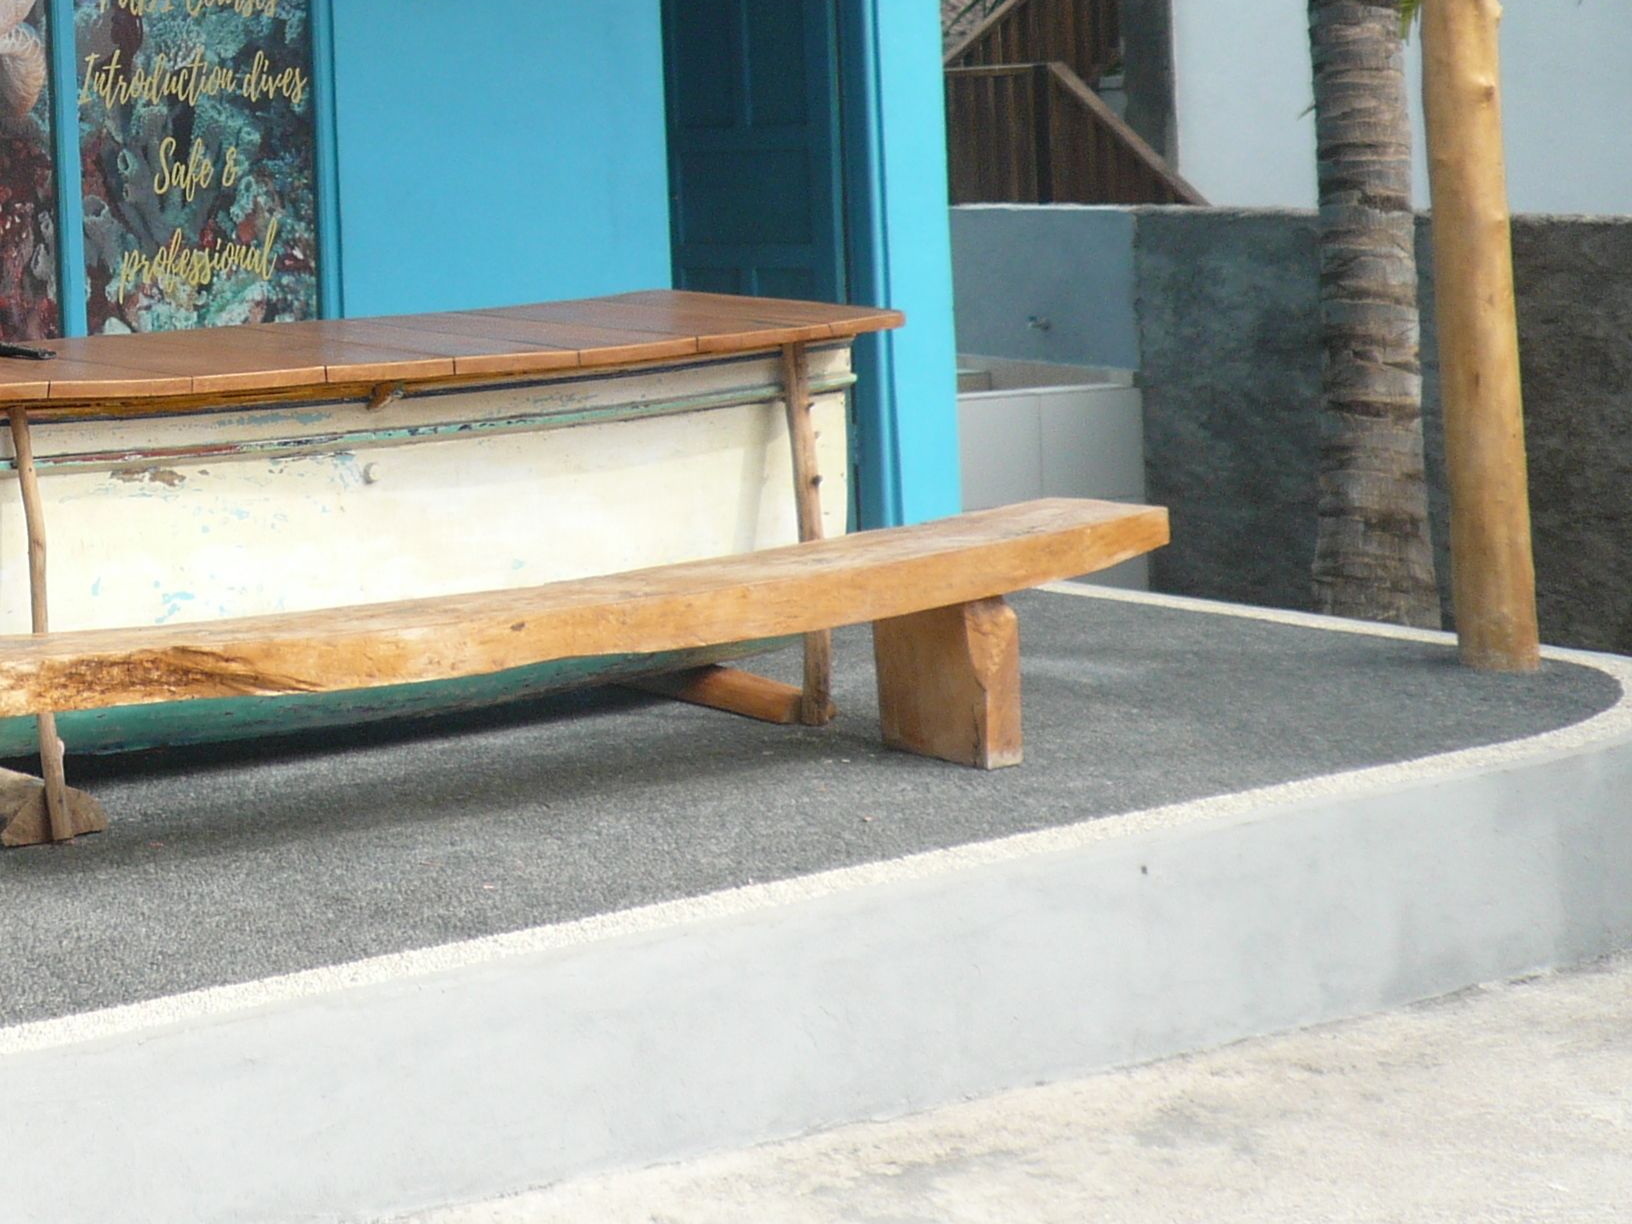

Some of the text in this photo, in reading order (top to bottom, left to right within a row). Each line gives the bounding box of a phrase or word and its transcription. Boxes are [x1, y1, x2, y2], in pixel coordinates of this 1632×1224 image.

[78, 46, 307, 109] Introduction dives
[153, 136, 238, 202] Safe &
[118, 220, 280, 305] professional
